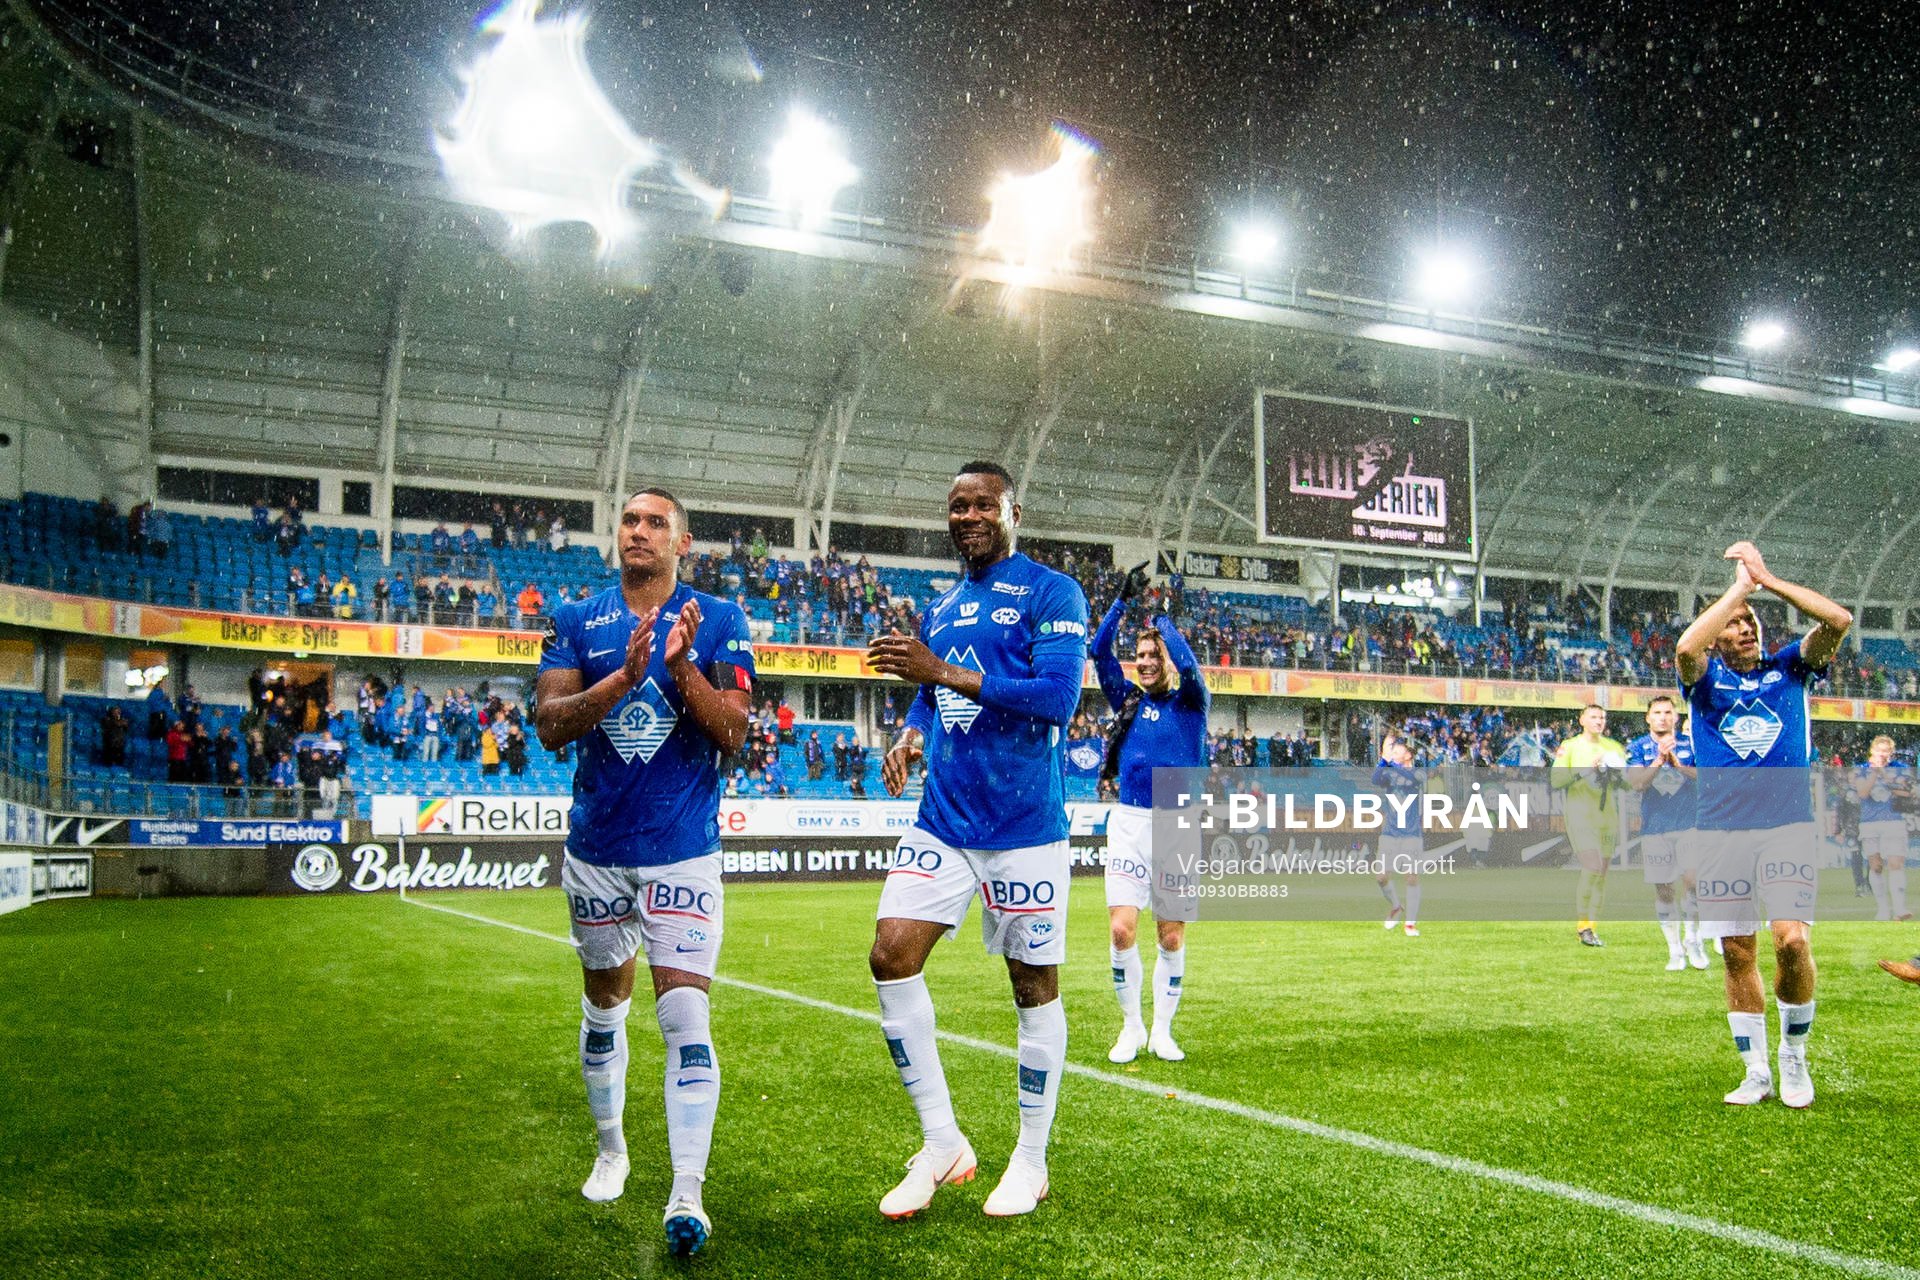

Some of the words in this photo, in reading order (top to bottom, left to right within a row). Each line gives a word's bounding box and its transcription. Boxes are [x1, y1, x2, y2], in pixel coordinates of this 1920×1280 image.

[220, 617, 267, 643] Oskar
[302, 624, 339, 650] Sylte
[497, 635, 538, 656] Oskar
[807, 651, 837, 673] Sylte
[1142, 705, 1160, 721] 30
[462, 800, 572, 831] Rekla
[797, 817, 834, 827] BMV
[840, 817, 861, 828] AS
[151, 834, 188, 845] Elektro
[221, 824, 266, 841] Sund
[269, 825, 333, 842] Elektro
[350, 843, 549, 892] Bakehuset
[794, 852, 801, 871] I
[807, 850, 860, 871] DITT
[897, 846, 942, 871] DO
[1111, 858, 1146, 879] BDO
[1766, 861, 1814, 881] BDO
[993, 880, 1055, 905] BDO
[1699, 879, 1752, 897] BDO
[574, 895, 633, 919] BDO
[655, 884, 716, 914] BDO
